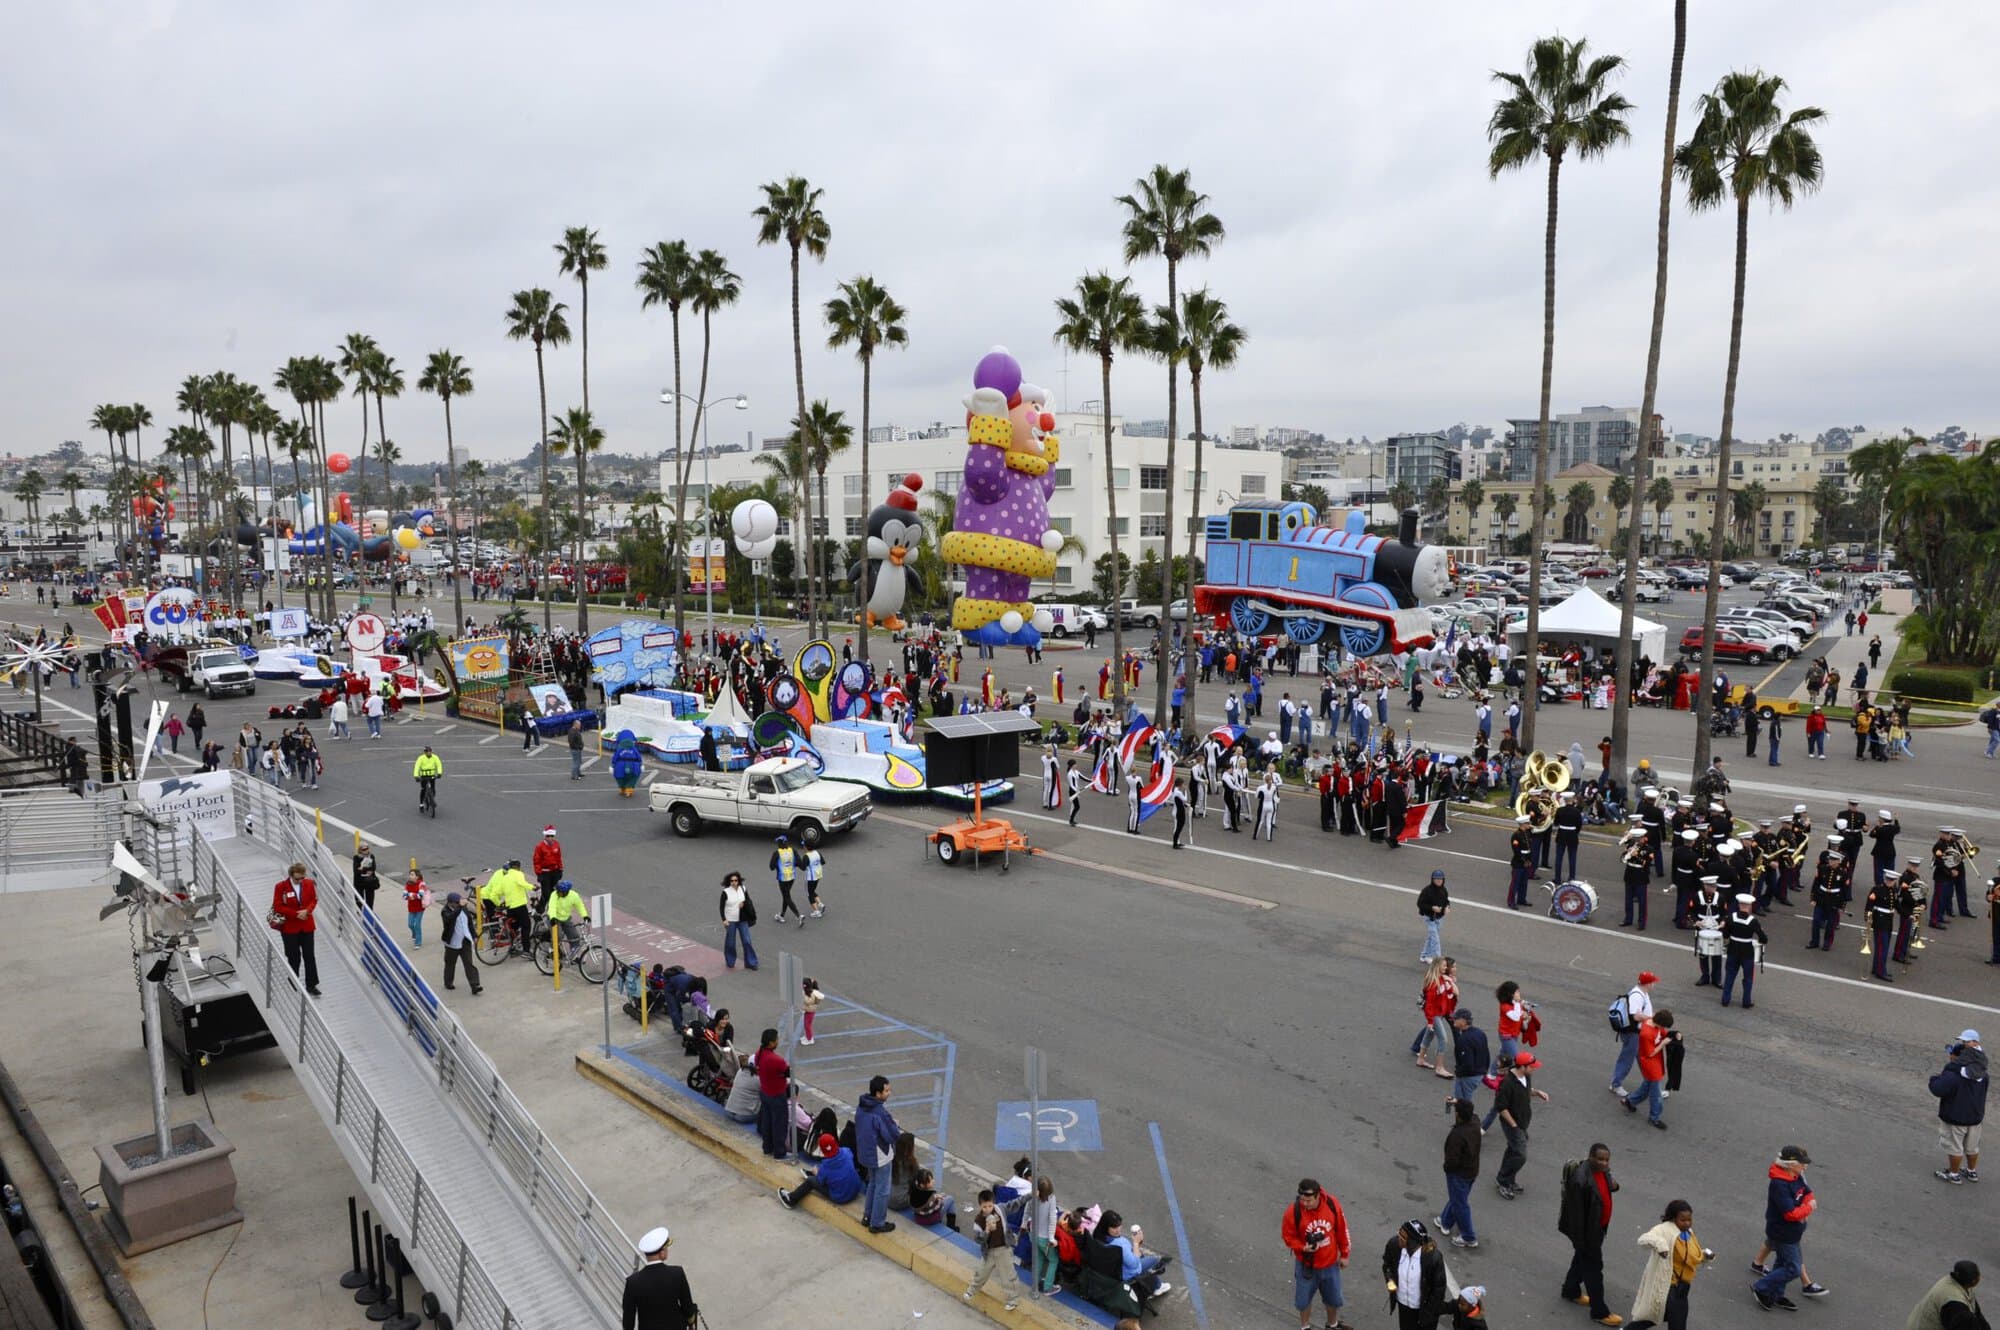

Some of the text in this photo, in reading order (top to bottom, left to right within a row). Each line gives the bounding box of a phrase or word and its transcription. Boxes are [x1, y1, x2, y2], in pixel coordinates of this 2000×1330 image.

[1288, 557, 1298, 580] 1
[281, 614, 298, 629] A
[357, 619, 375, 635] N
[197, 794, 225, 807] Port
